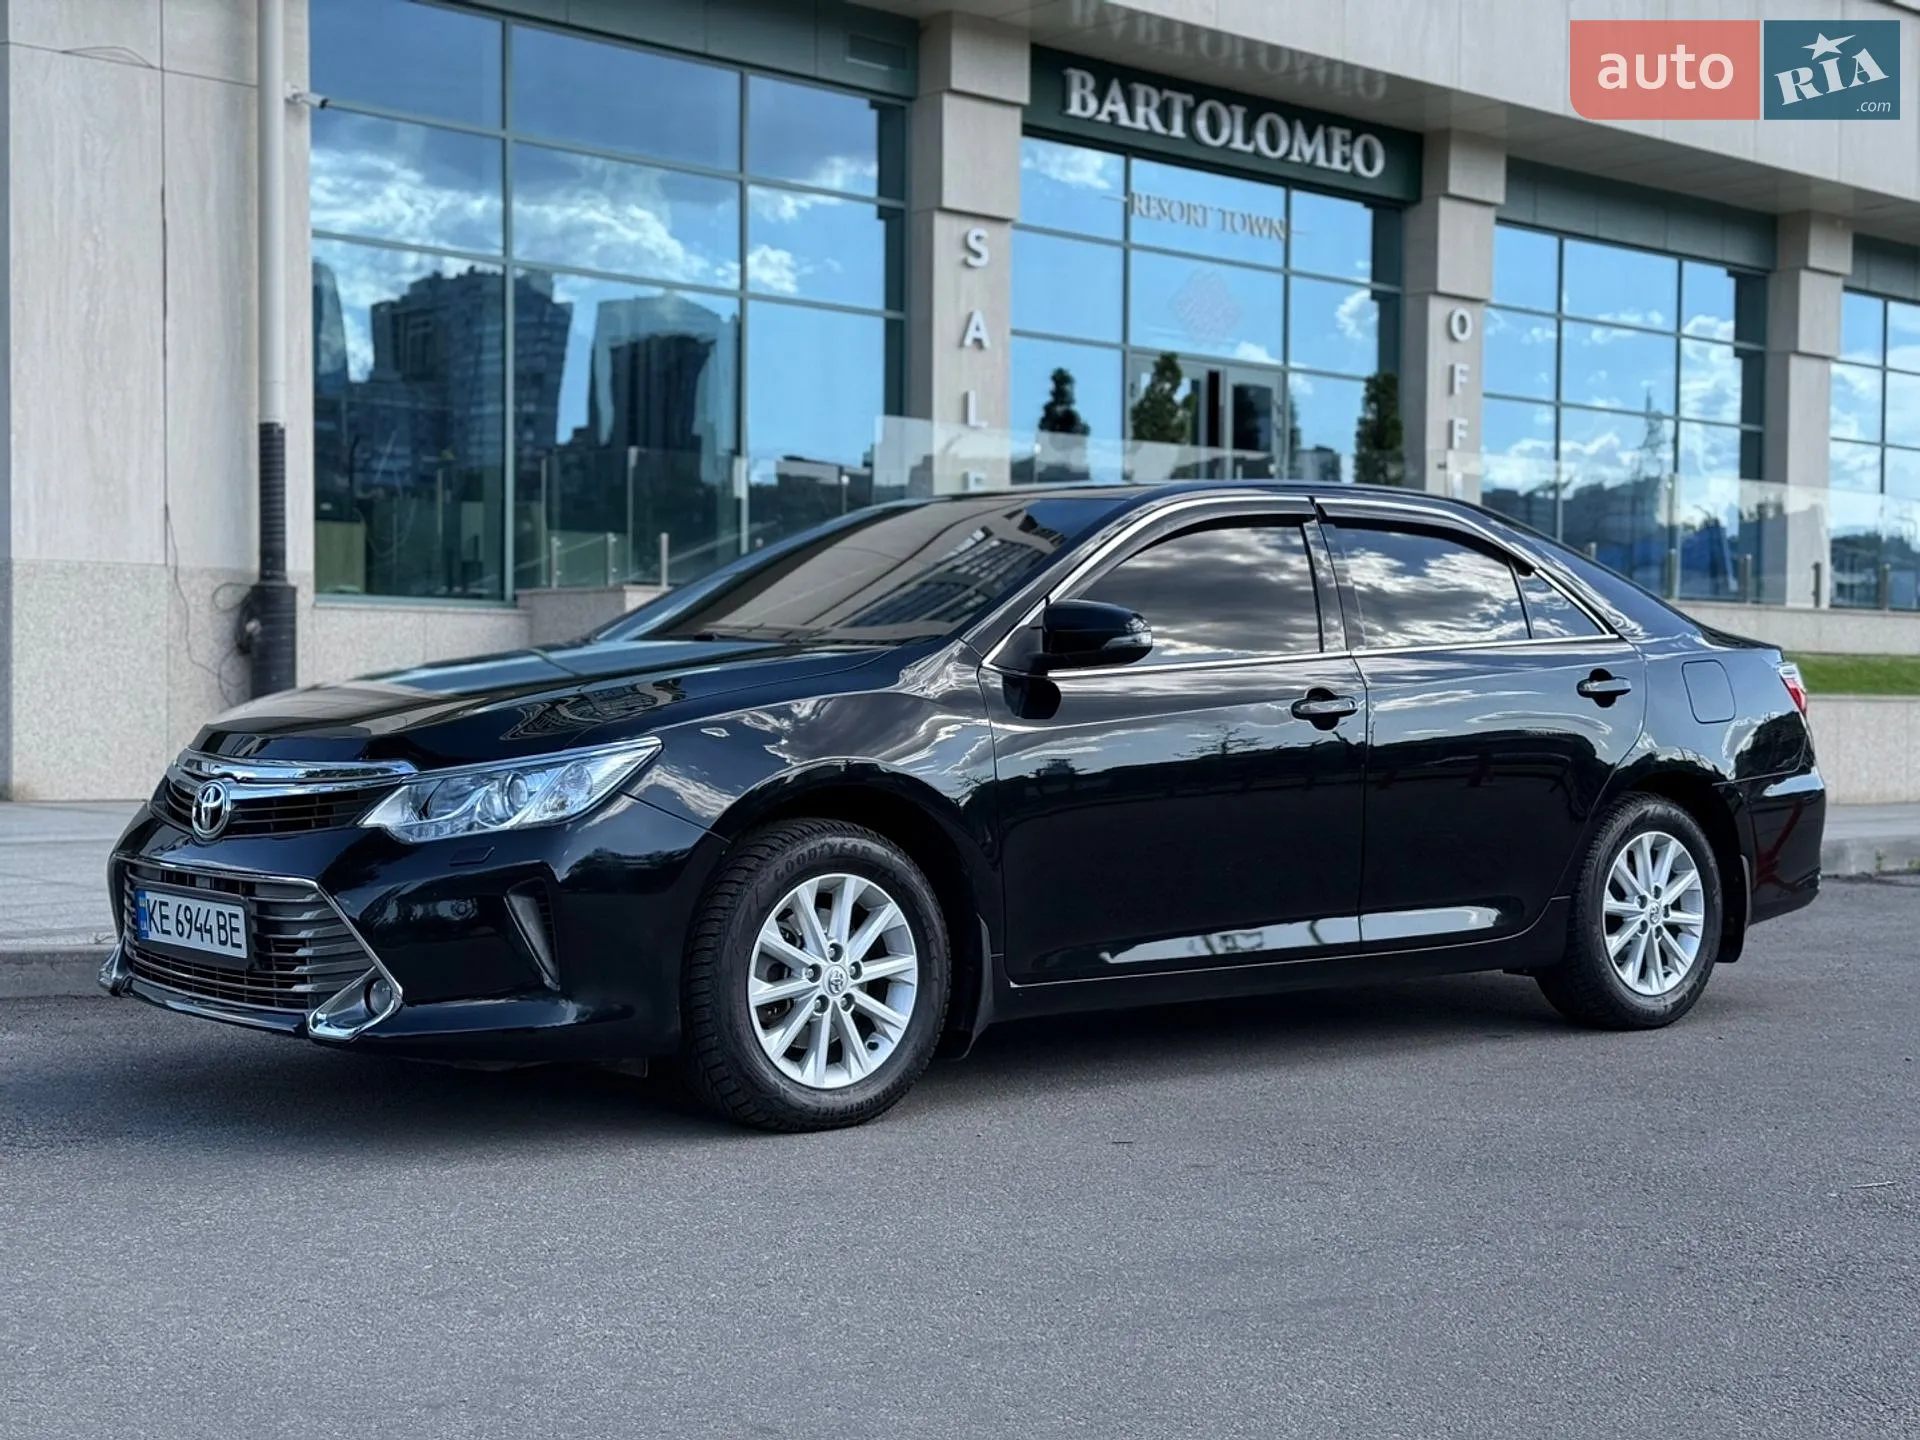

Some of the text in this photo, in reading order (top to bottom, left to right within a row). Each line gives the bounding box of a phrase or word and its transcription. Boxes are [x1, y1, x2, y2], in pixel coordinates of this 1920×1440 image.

[1064, 66, 1386, 179] BARTOLOMEO
[1127, 191, 1288, 241] RESORT TOWN
[774, 842, 872, 881] GOODYEAR
[146, 899, 243, 949] KE 6944 BE
